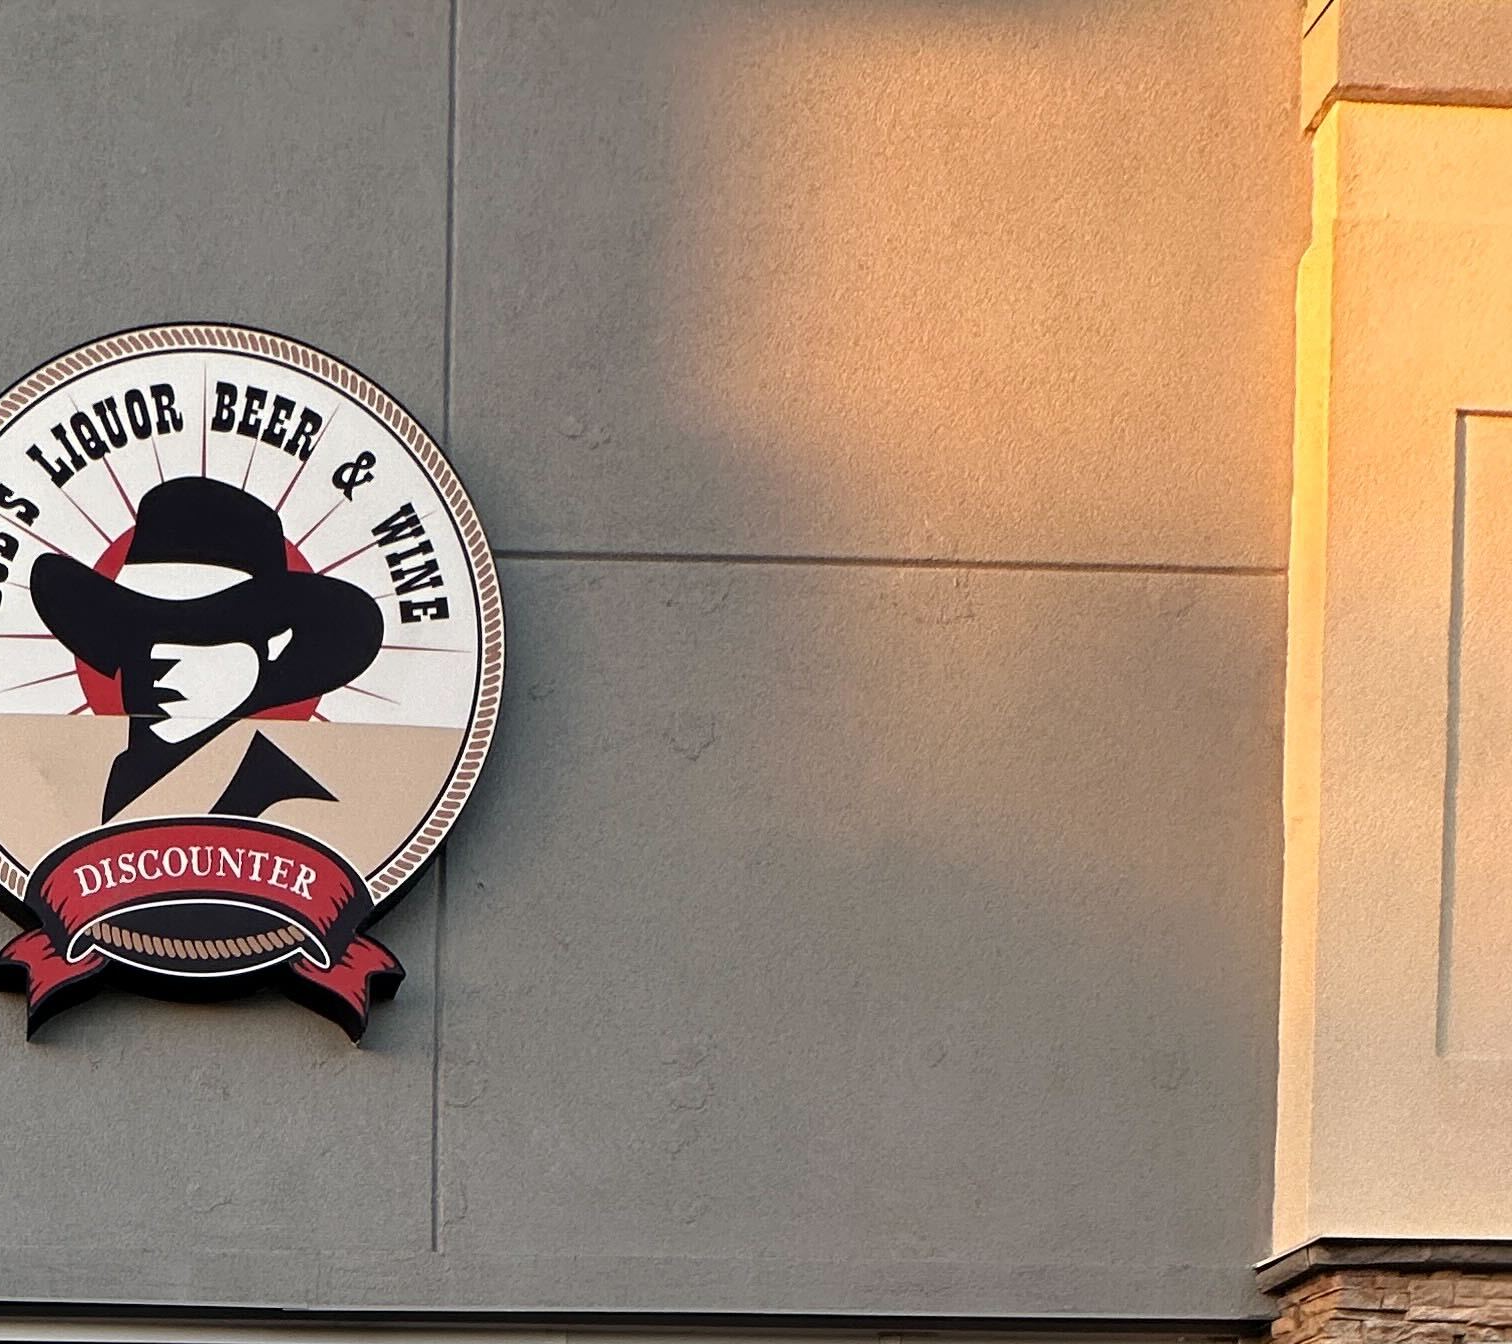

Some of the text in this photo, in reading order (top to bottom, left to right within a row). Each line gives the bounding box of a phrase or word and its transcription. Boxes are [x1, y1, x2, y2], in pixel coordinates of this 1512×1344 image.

[26, 383, 185, 489] LIQUOR
[210, 381, 324, 463] BEER
[332, 450, 377, 502] &
[371, 501, 451, 625] WINE
[73, 846, 317, 901] DISCOUNTER
